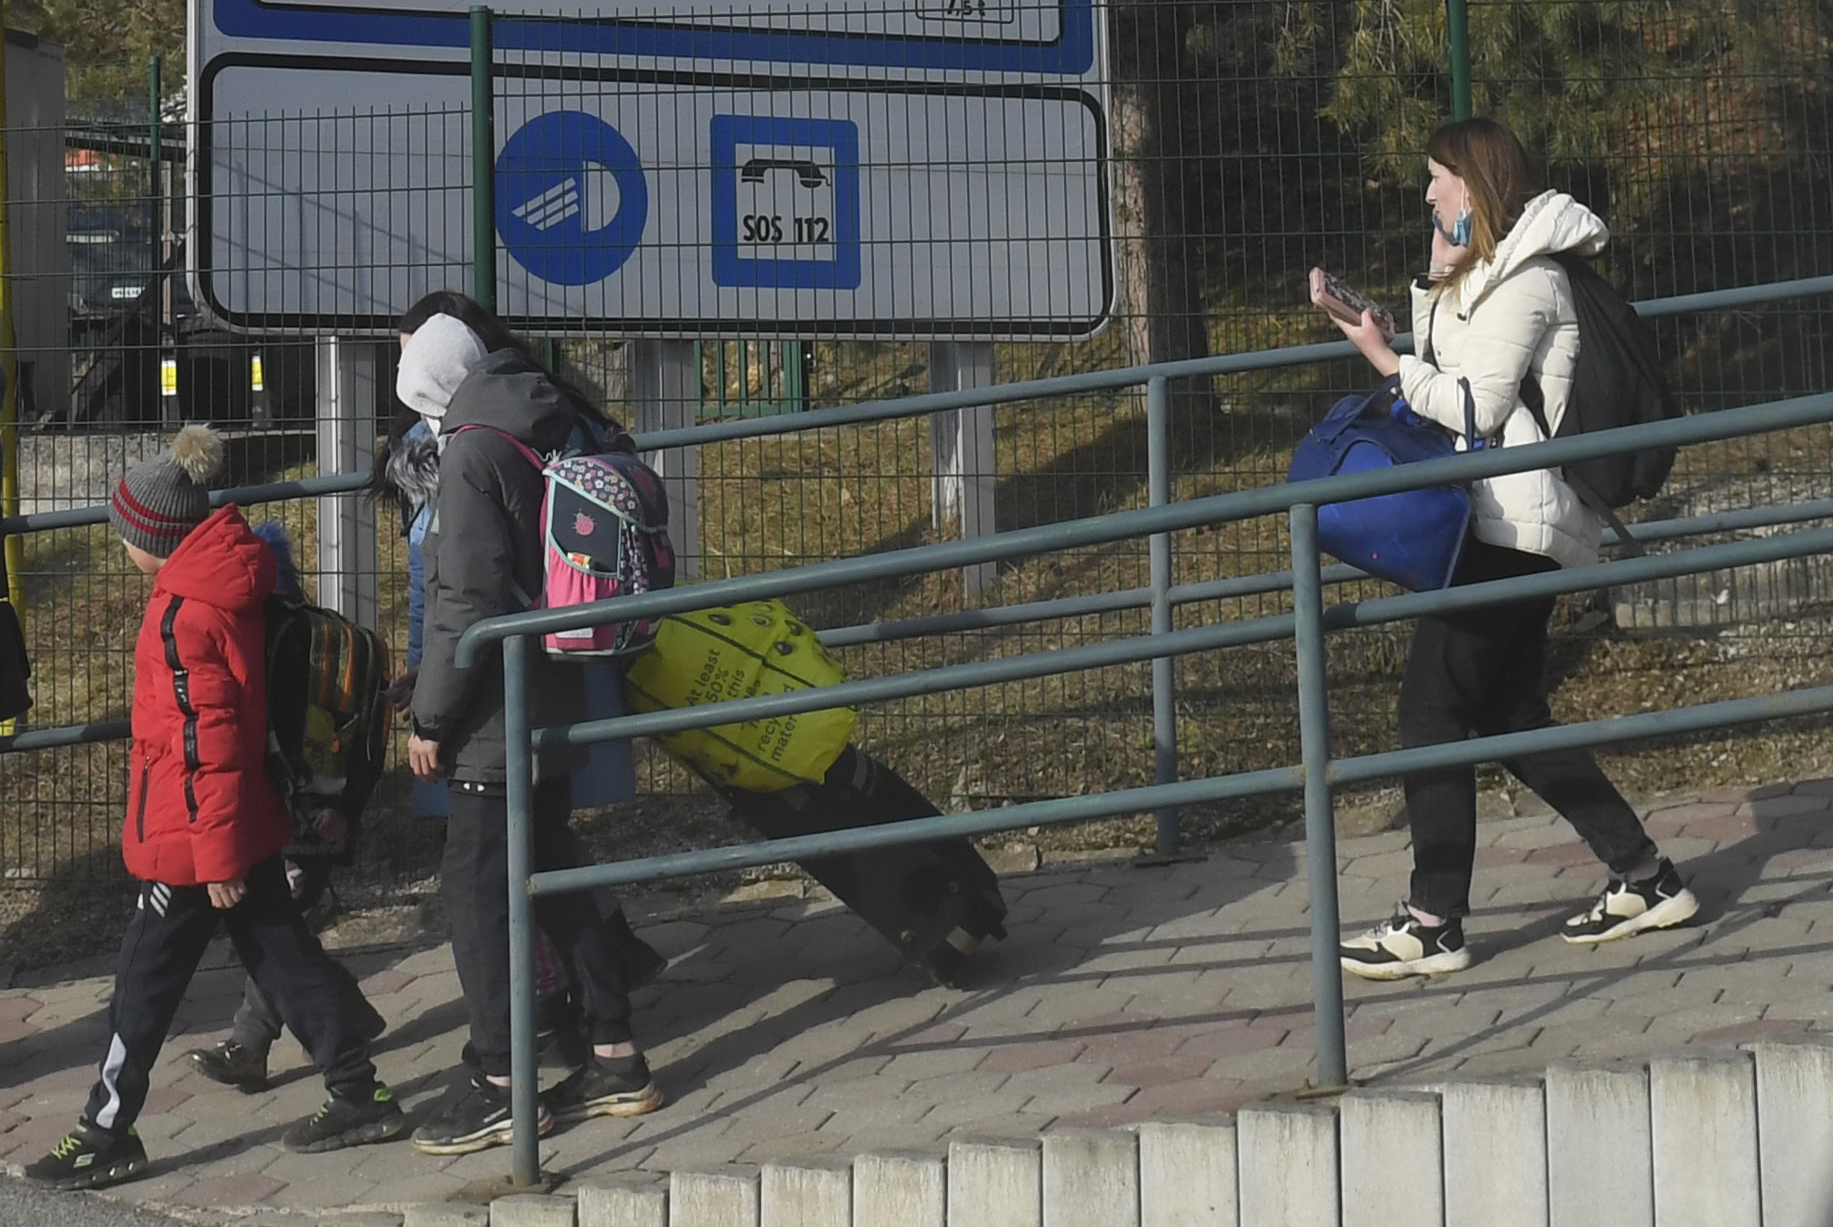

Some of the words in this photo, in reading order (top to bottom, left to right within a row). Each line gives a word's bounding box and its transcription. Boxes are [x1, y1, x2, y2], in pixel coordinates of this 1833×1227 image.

[742, 213, 784, 243] SOS
[793, 216, 830, 244] 112
[695, 648, 721, 687] least
[705, 666, 730, 703] 50%
